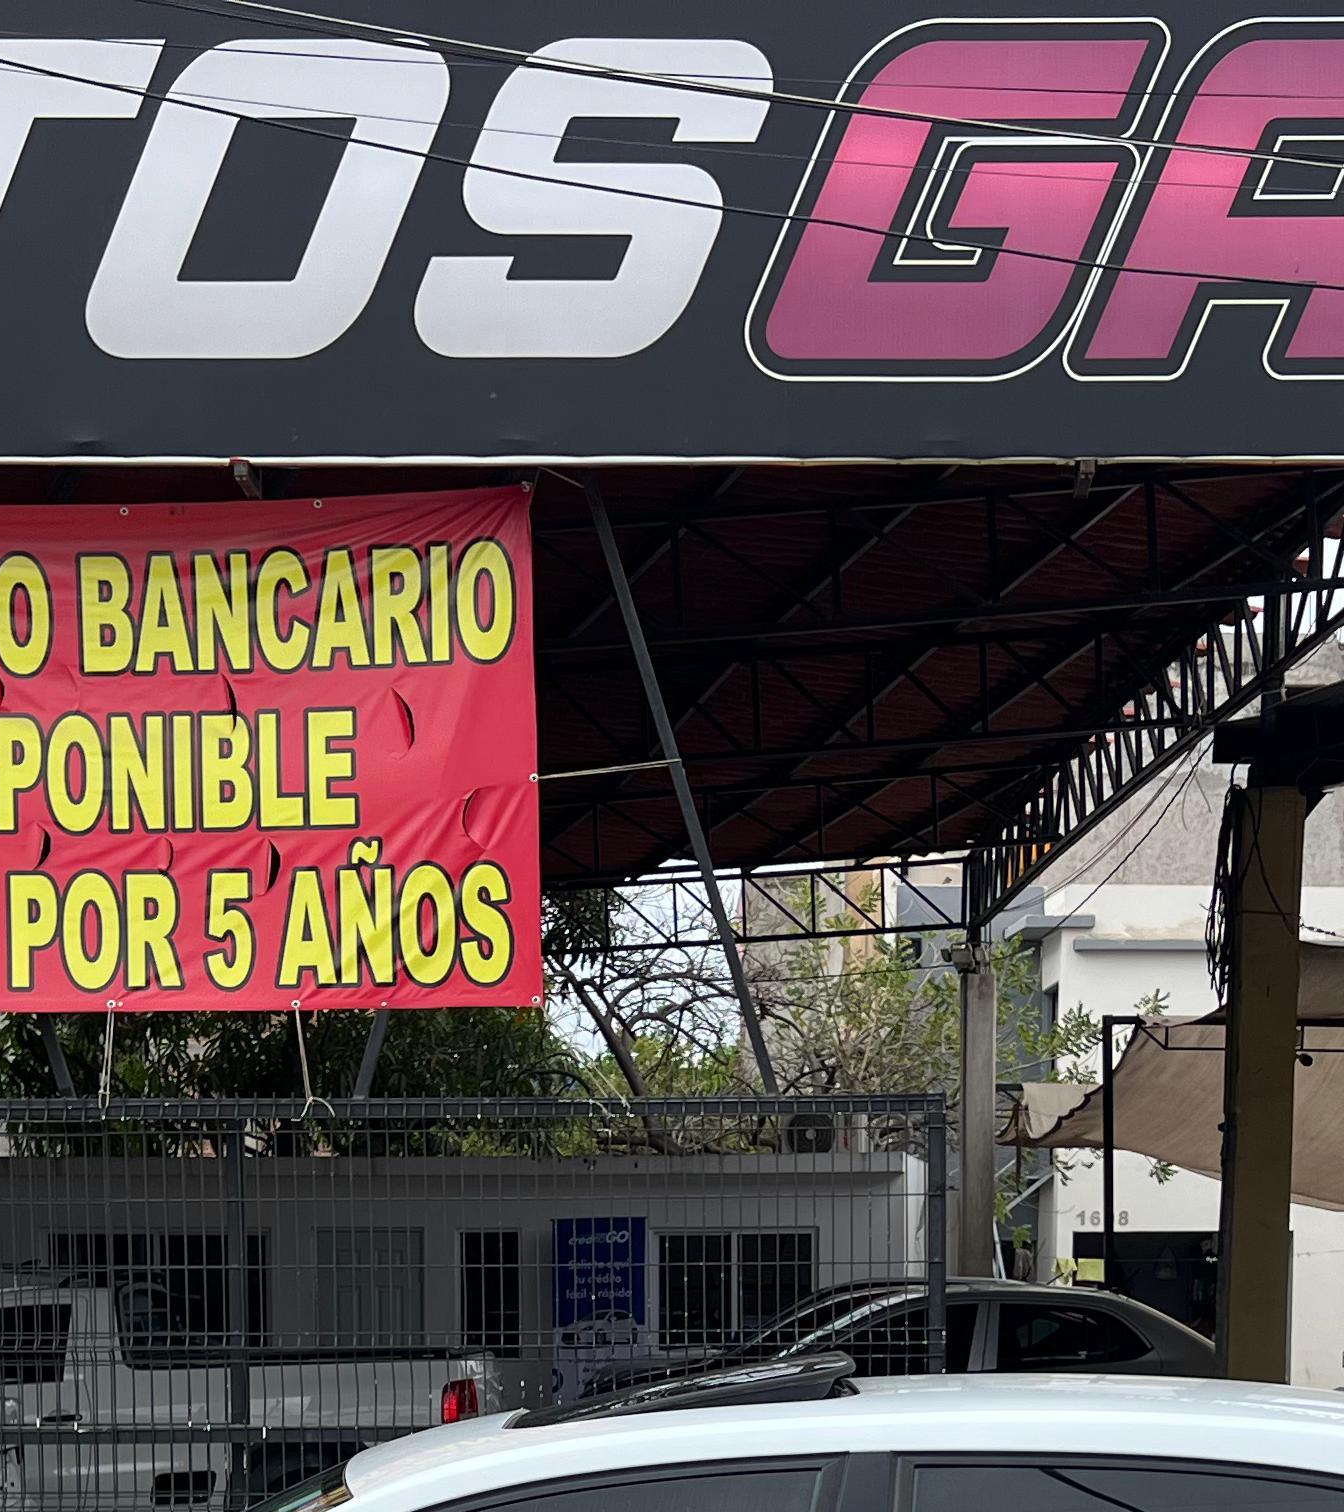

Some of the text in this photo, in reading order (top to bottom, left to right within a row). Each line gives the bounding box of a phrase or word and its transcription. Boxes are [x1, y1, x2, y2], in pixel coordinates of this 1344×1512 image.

[75, 537, 517, 676] BANCARIO
[1, 869, 185, 993] POR
[203, 869, 257, 993] 5
[273, 836, 516, 992] AÑOS
[1075, 1210, 1130, 1226] 168
